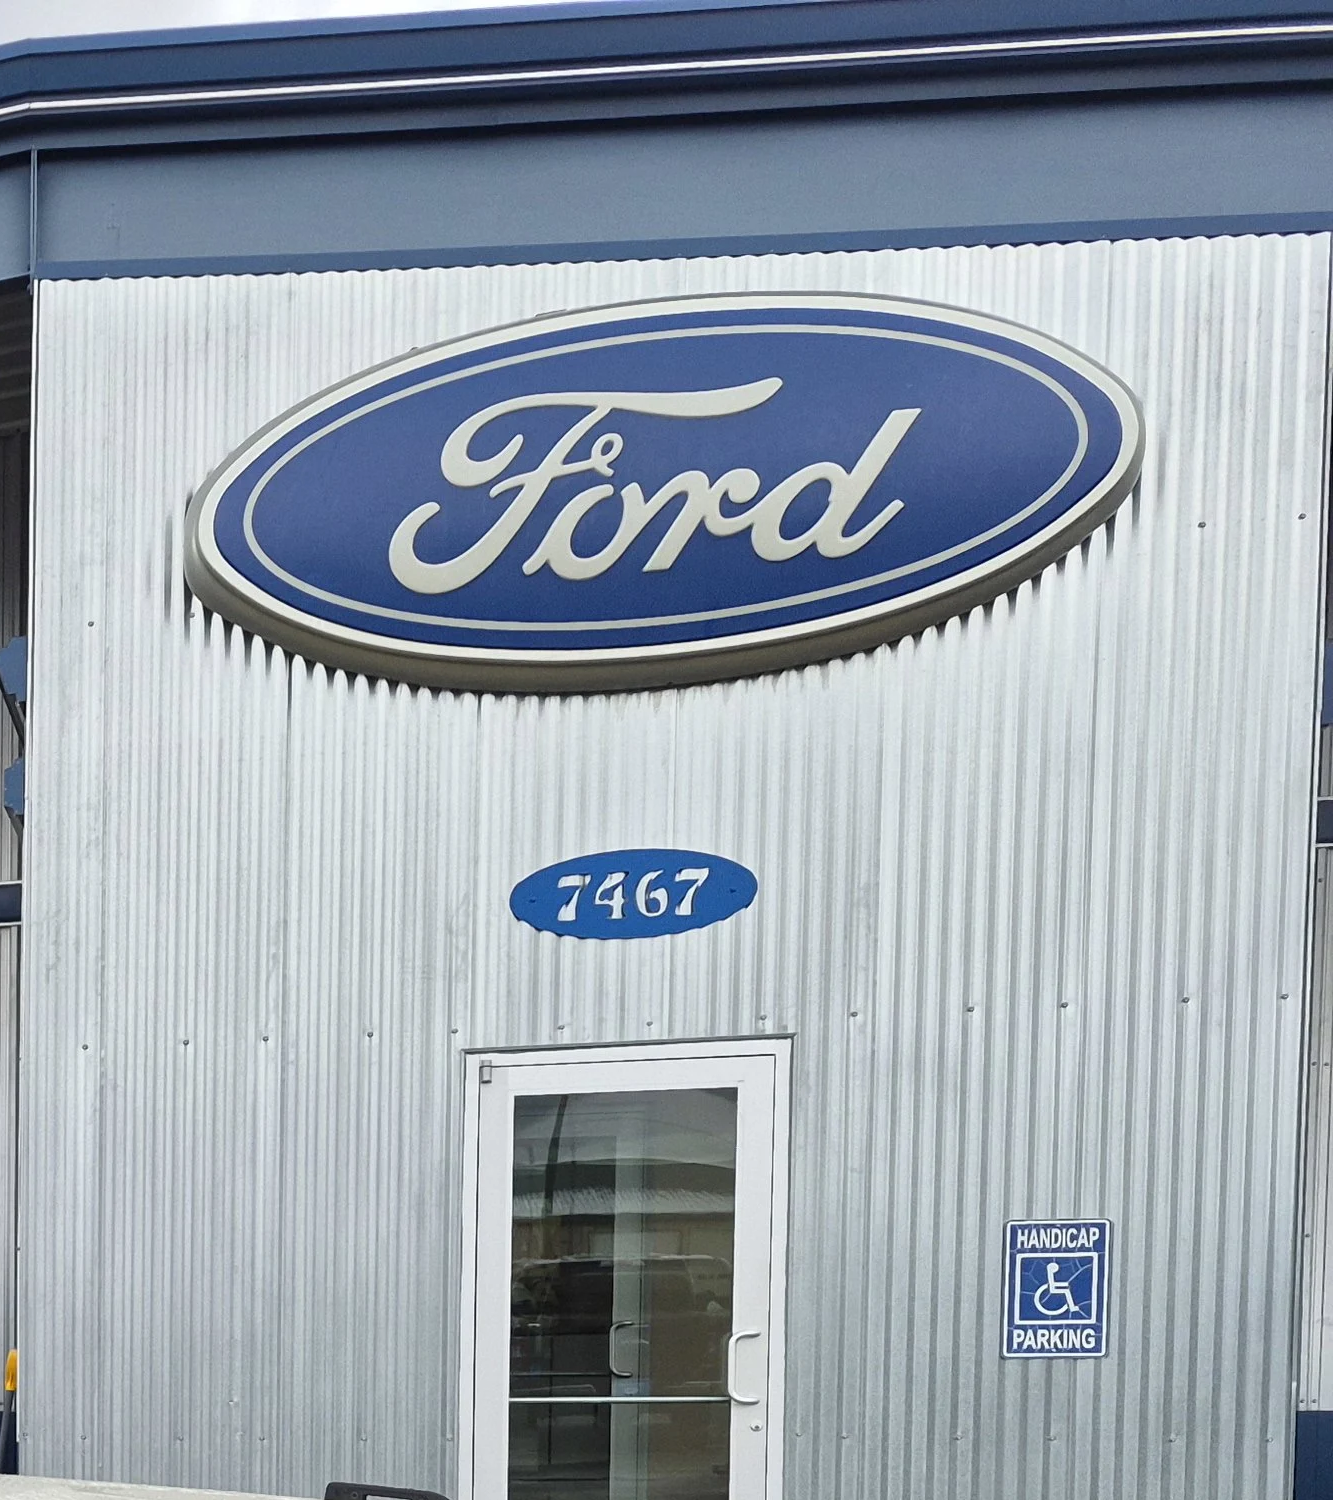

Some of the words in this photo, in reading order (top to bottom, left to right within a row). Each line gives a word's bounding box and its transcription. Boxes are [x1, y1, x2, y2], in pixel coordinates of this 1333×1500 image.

[388, 377, 921, 594] Ford
[555, 866, 710, 923] 7467
[1017, 1227, 1100, 1249] HANDICAP
[1013, 1328, 1096, 1350] PARKING
